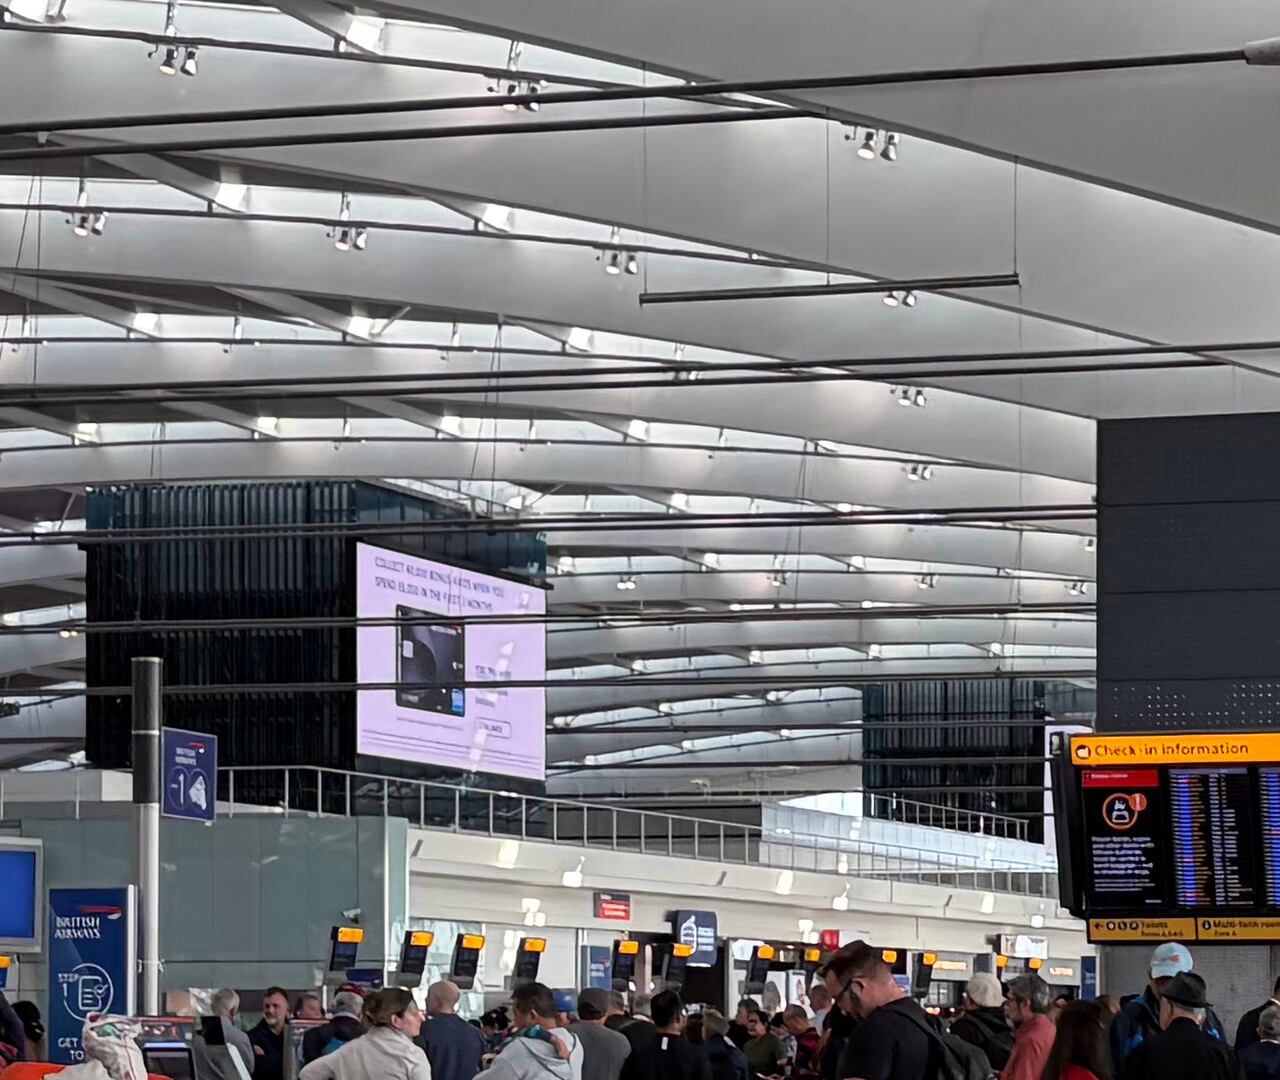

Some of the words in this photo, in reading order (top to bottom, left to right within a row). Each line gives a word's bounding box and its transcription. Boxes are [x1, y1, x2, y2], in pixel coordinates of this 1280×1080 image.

[1161, 741, 1249, 756] information
[56, 916, 100, 929] BRITISH
[54, 928, 101, 939] AIRWAYS
[58, 973, 79, 983] STEP
[57, 1037, 79, 1048] GET
